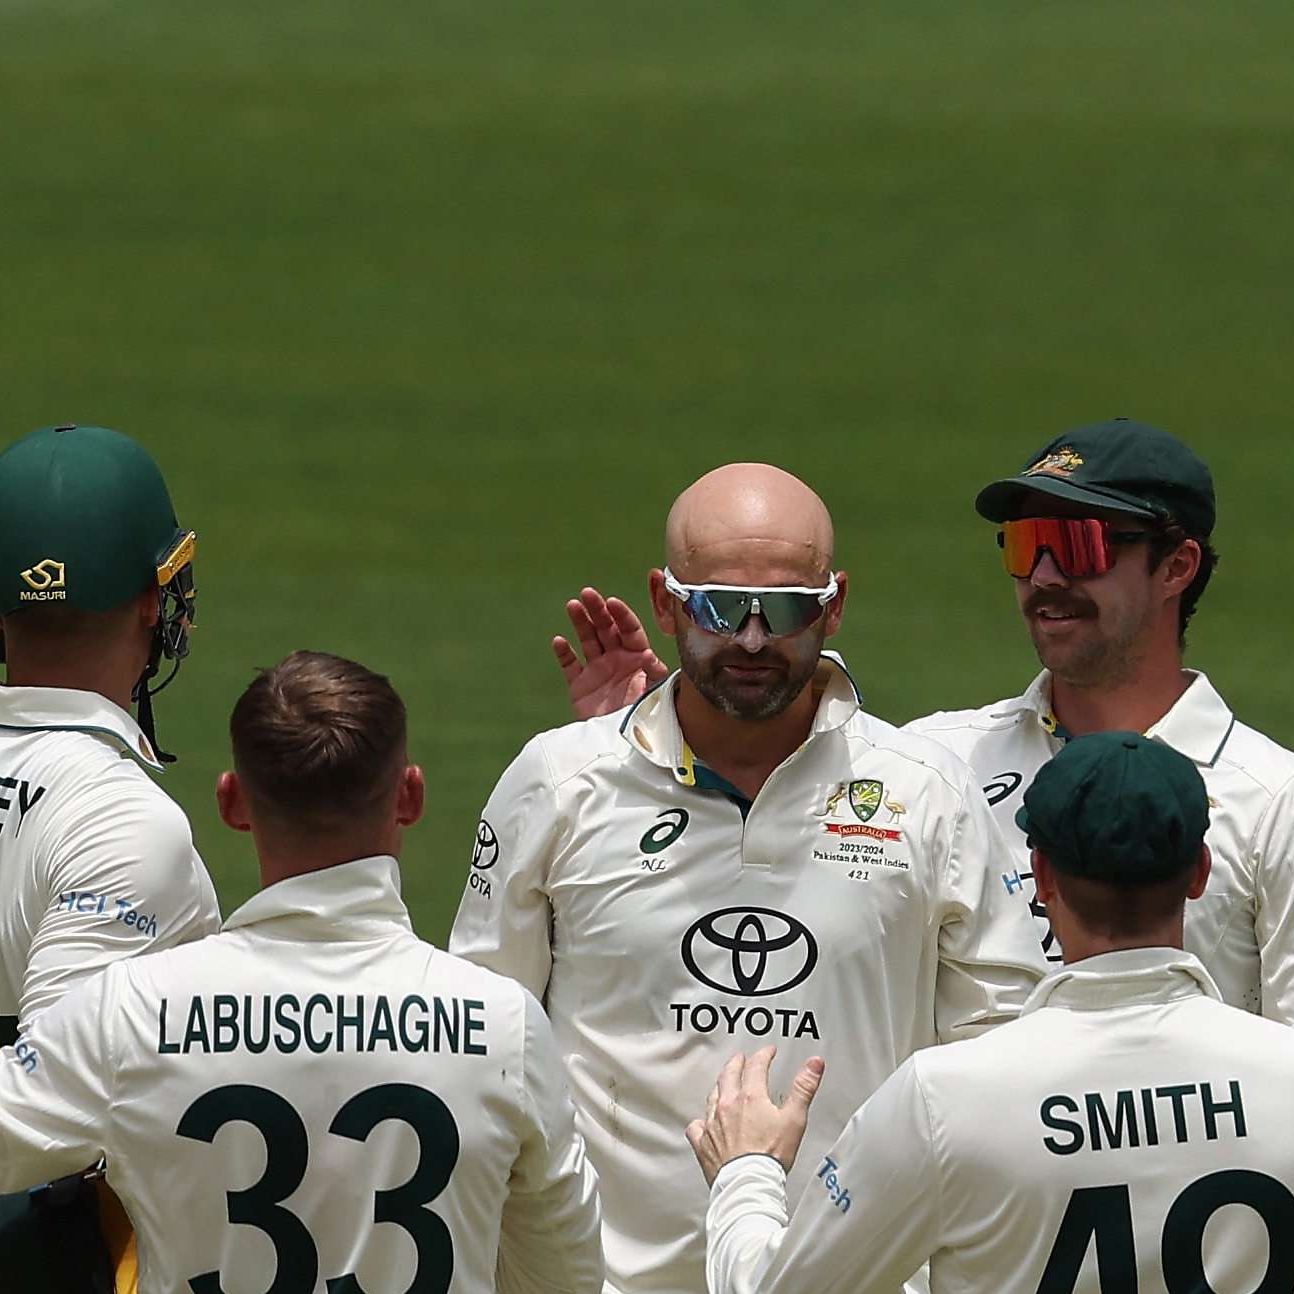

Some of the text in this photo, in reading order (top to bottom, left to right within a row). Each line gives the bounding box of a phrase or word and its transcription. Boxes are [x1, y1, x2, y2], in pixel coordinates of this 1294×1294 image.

[20, 590, 66, 600] MASURI
[841, 825, 884, 839] AUSTRALIA
[839, 843, 884, 855] 2023/2024
[641, 858, 666, 872] NL
[813, 850, 909, 869] Pakistan & West Indies
[848, 870, 870, 881] 421
[158, 994, 488, 1056] LABUSCHAGNE
[669, 1003, 820, 1040] TOYOTA
[1039, 1080, 1248, 1156] SMITH
